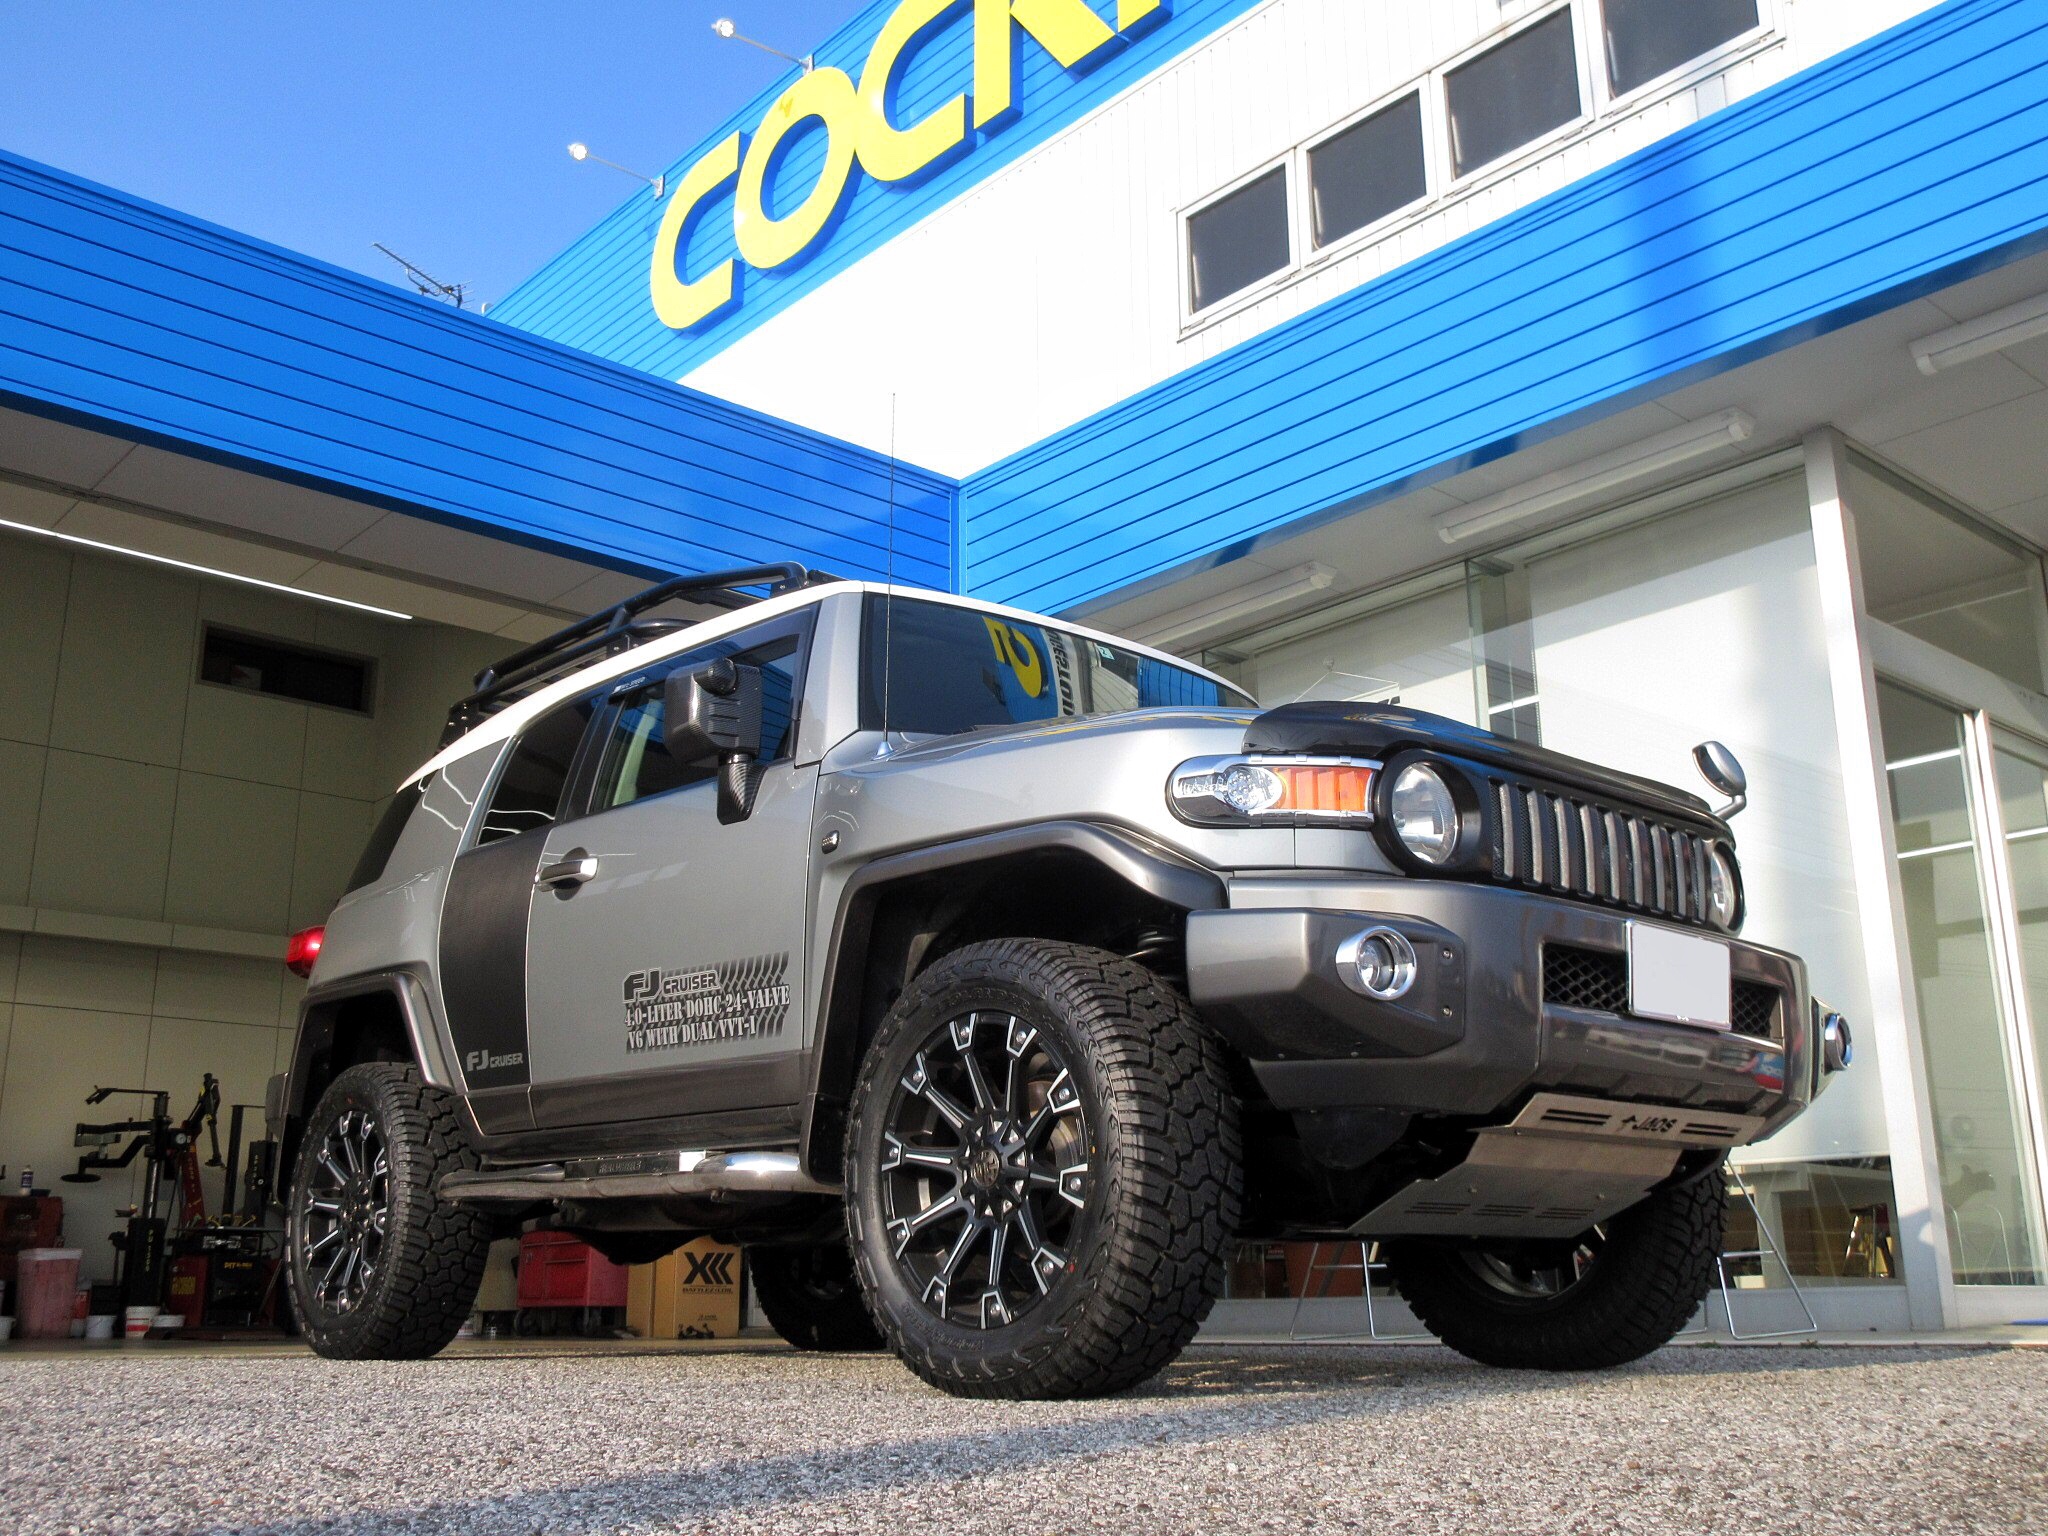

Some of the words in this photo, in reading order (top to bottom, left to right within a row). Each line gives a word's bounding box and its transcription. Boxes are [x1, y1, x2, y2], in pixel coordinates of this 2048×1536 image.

[623, 968, 661, 1003] FJ
[663, 971, 719, 995] CRUISER
[625, 1001, 684, 1028] 4.0-LITER
[686, 994, 722, 1019] DOHC
[725, 985, 791, 1013] 24-VALVE
[628, 1031, 644, 1049] V6
[646, 1026, 679, 1047] WITH
[682, 1021, 716, 1043] DUAL
[719, 1015, 756, 1038] VVT-I
[466, 1049, 489, 1071] FJ
[490, 1052, 524, 1068] CRUISER
